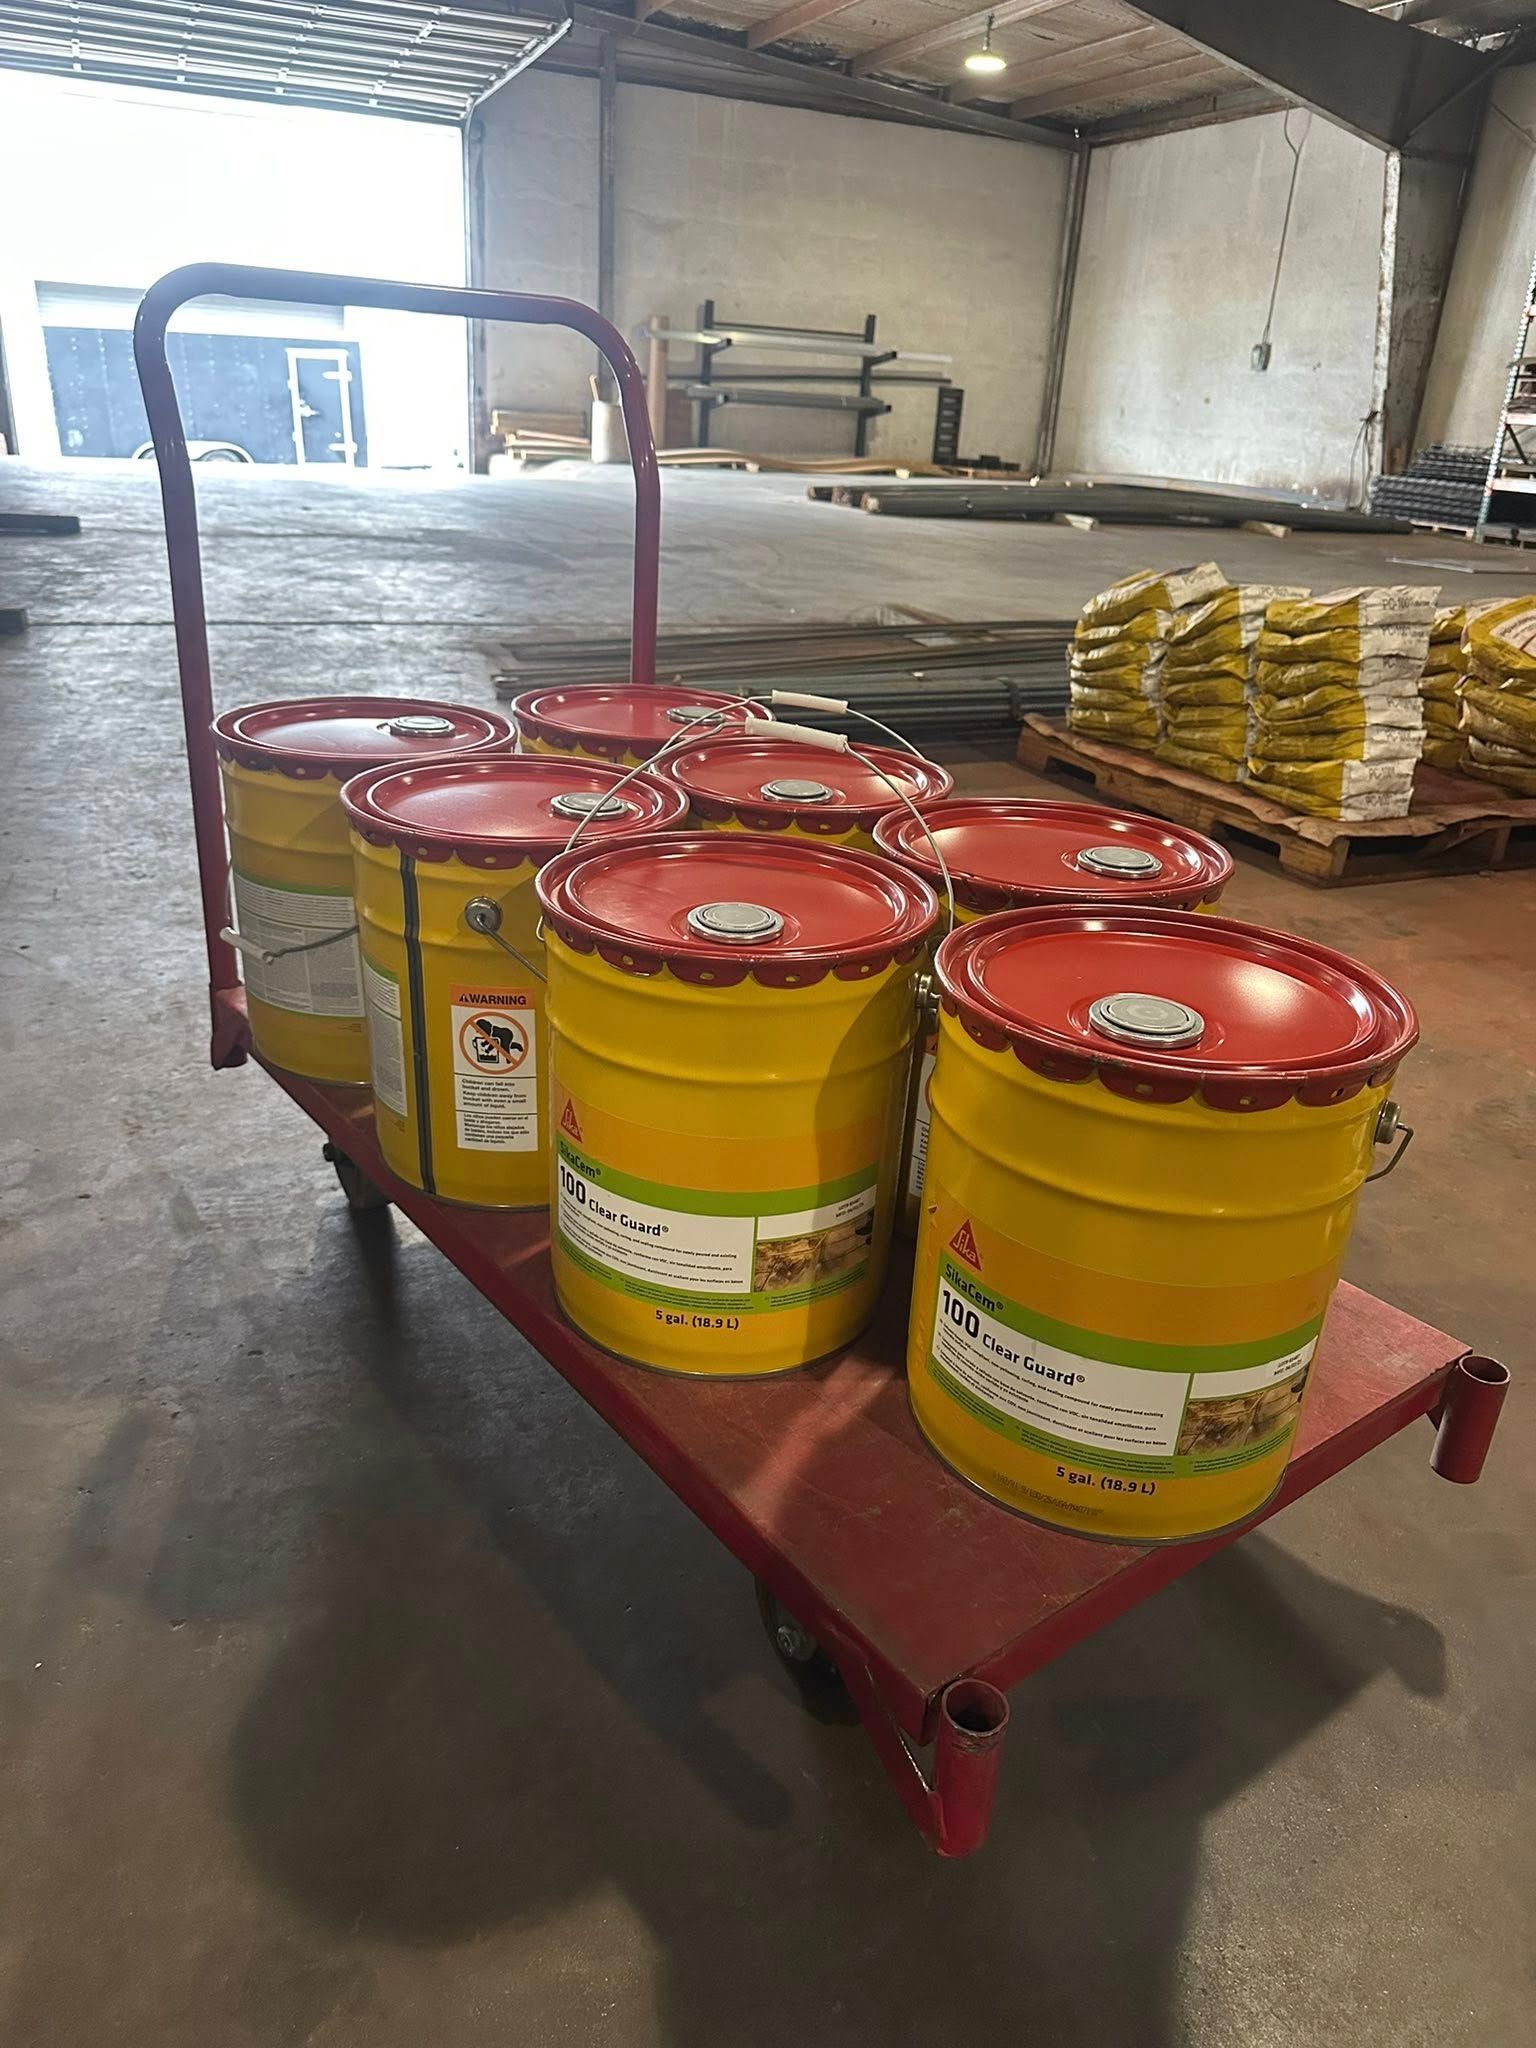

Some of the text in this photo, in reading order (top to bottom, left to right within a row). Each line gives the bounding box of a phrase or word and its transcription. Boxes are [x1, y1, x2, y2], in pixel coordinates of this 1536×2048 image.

[469, 993, 527, 1006] WARNING
[560, 1165, 586, 1205] 100
[589, 1198, 618, 1222] Clear
[952, 1229, 977, 1264] Sika
[655, 1309, 740, 1330] 5 gal. (18.9 L)
[943, 1289, 980, 1338] 100
[983, 1333, 1020, 1364] Clear
[1056, 1466, 1156, 1495] 5 gal. (18.9 L)
